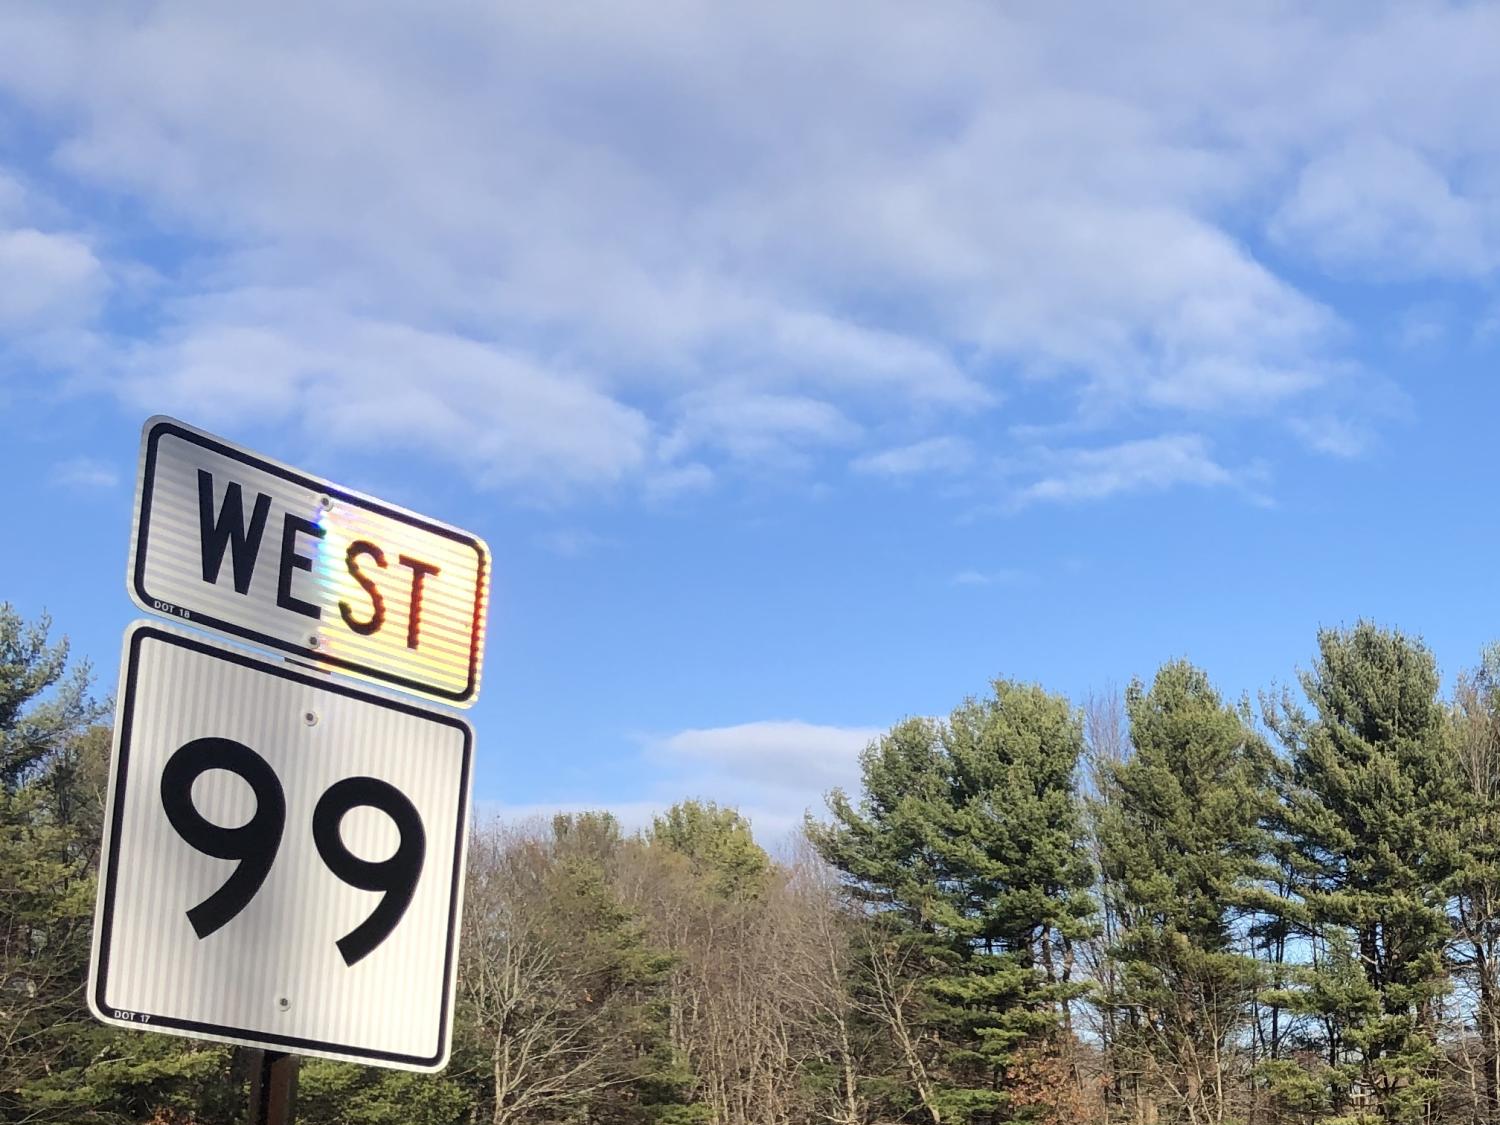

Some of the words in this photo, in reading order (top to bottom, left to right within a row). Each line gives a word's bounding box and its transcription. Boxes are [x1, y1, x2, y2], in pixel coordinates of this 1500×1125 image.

[154, 600, 175, 613] DOT
[179, 608, 190, 618] 18
[197, 467, 442, 651] WEST
[160, 737, 427, 968] 99
[114, 1010, 136, 1021] DOT
[140, 1014, 151, 1023] 17
